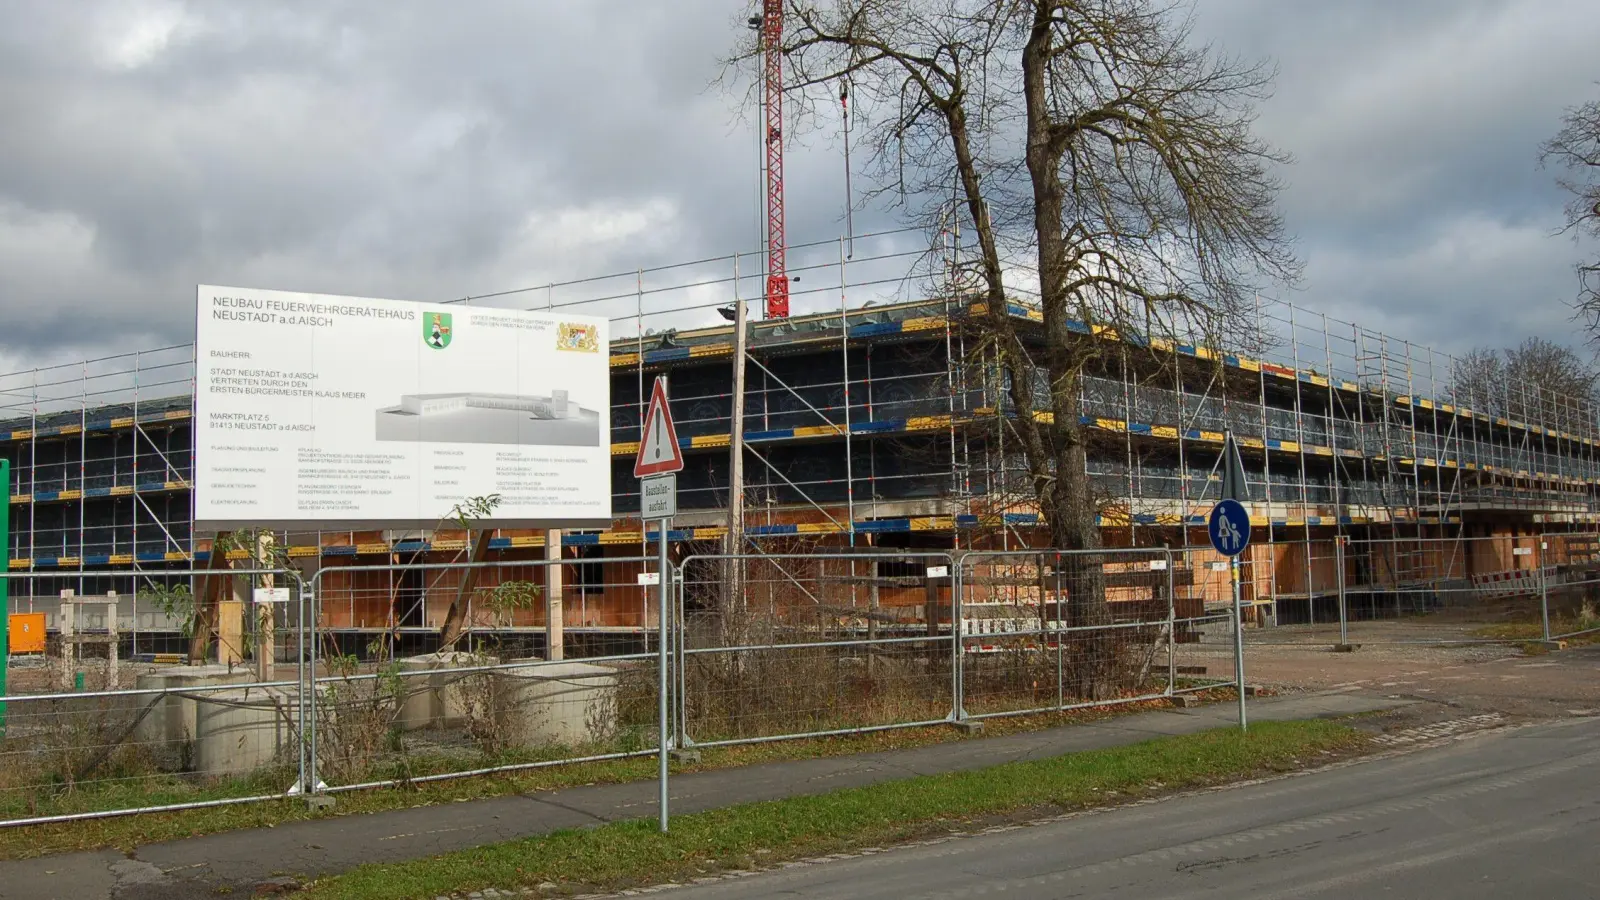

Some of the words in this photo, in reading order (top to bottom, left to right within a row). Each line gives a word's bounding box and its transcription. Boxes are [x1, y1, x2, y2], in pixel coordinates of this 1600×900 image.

[213, 296, 263, 310] NEUBAU
[266, 300, 415, 321] FEUERWEHRGERÄTEHAUS
[213, 310, 277, 324] NEUSTADT
[210, 368, 237, 376] STADT
[238, 369, 281, 378] NEUSTADT
[210, 377, 259, 386] VERTRETEN
[261, 379, 290, 387] DURCH
[291, 380, 308, 388] DEN
[210, 386, 244, 395] ERSTEN
[245, 387, 313, 397] BÜRGERMEISTER
[210, 413, 263, 421] MARKTPLATZ
[234, 422, 278, 431] NEUSTADT
[648, 499, 668, 512] ausfahrt
